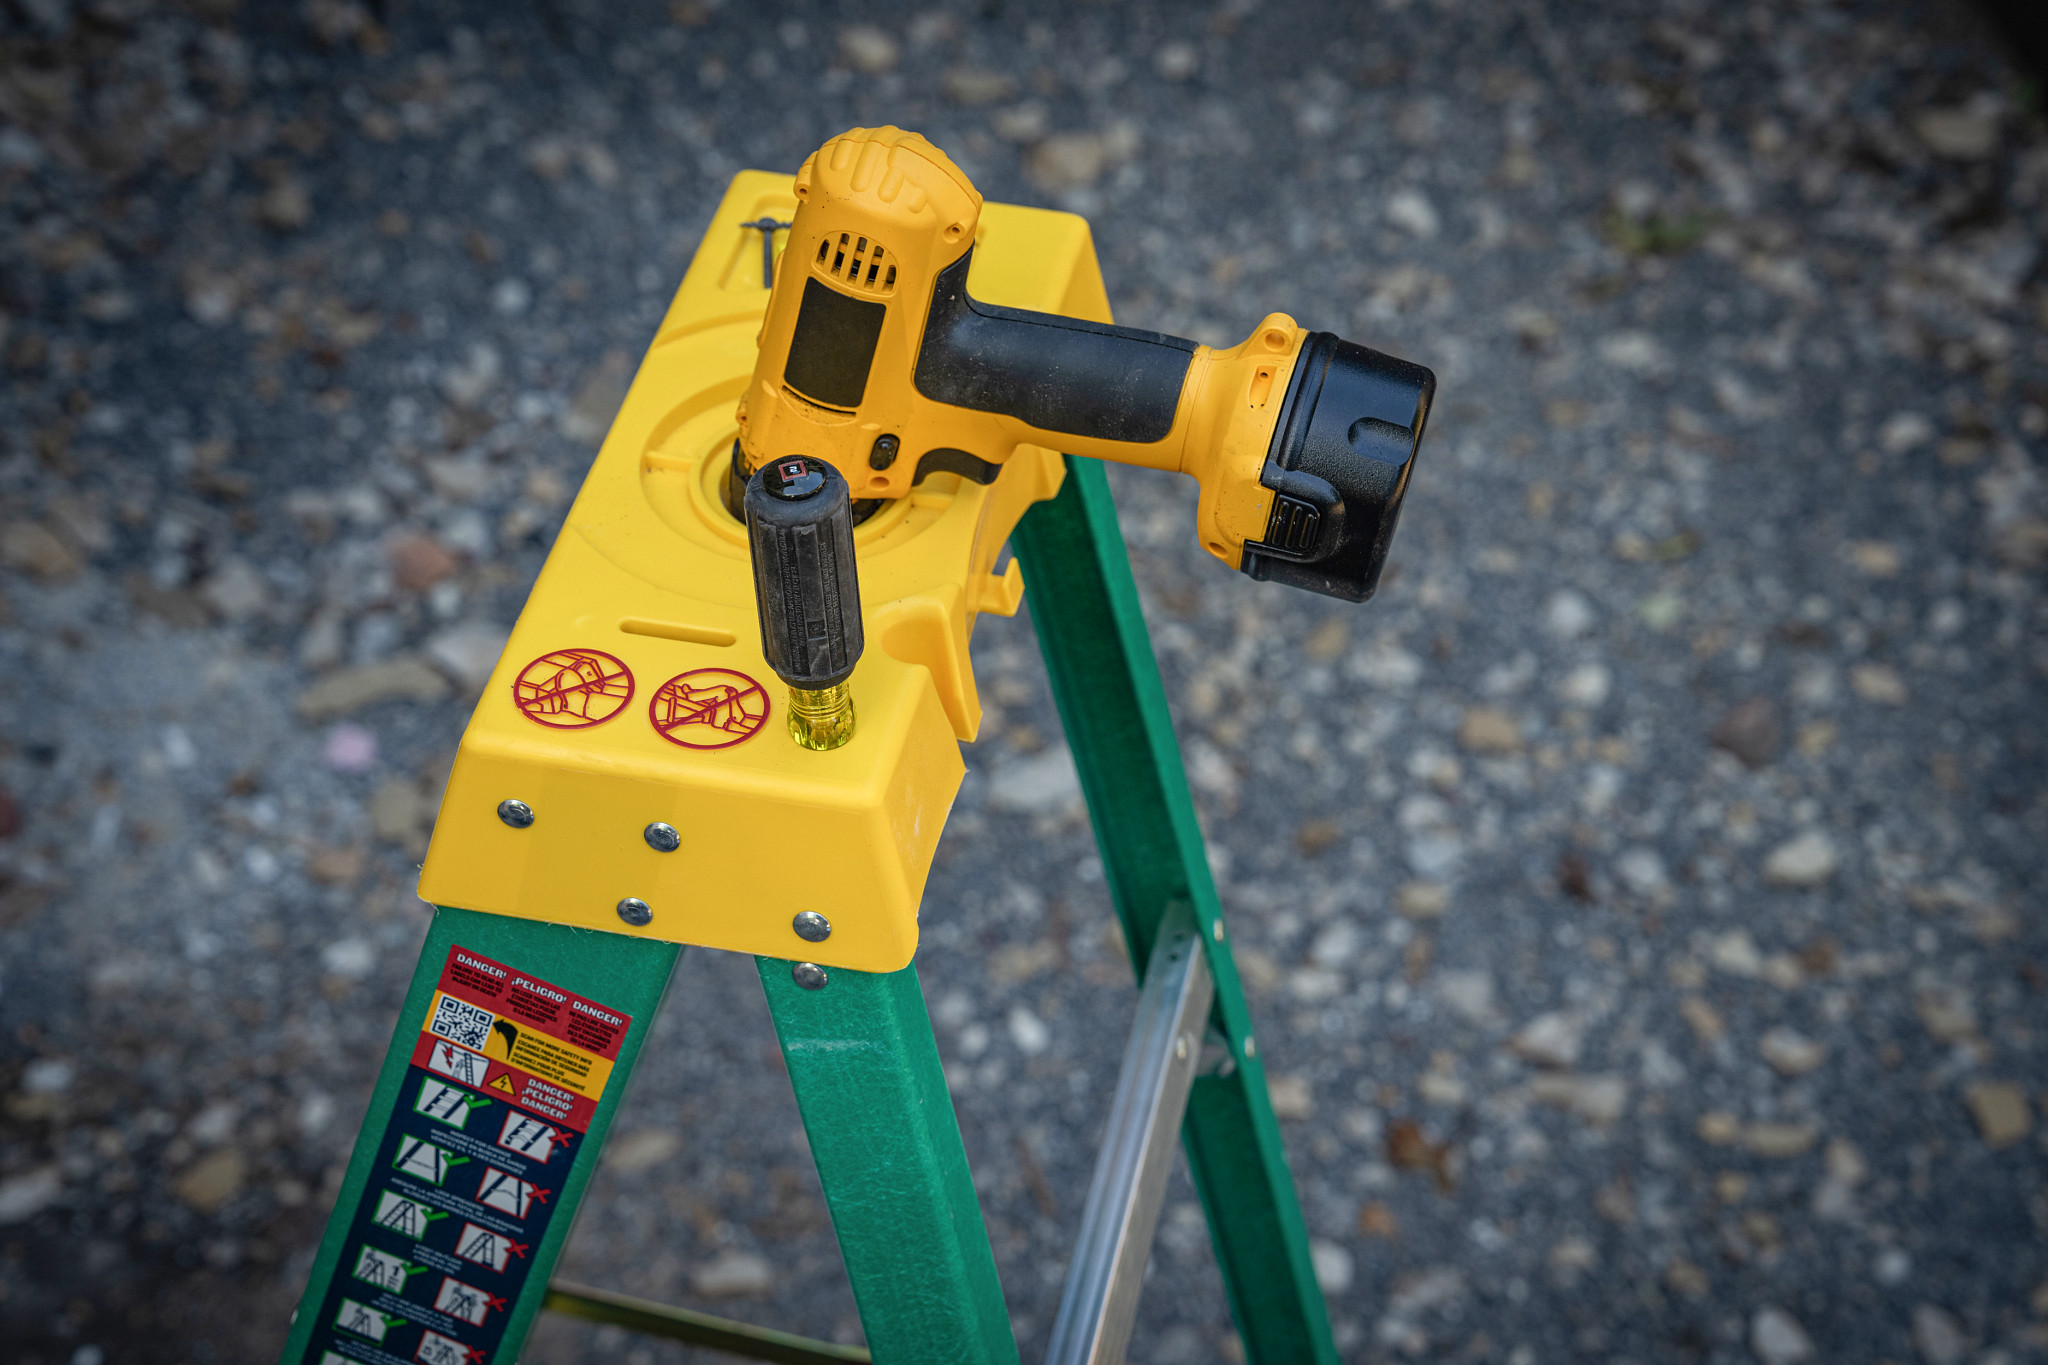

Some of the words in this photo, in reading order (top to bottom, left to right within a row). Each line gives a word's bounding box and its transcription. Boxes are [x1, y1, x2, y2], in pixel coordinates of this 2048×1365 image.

[451, 963, 473, 975] FAILURE
[480, 974, 494, 983] READ
[456, 953, 507, 979] DANGER!
[450, 969, 470, 980] LABELS
[469, 976, 481, 984] CAN
[481, 981, 494, 990] LEAD
[451, 976, 470, 987] INJURY
[479, 987, 496, 997] DEATH
[510, 975, 567, 1005] ¡PELIGRO!
[572, 1000, 622, 1026] DANGER!
[519, 1032, 534, 1041] SCAN
[534, 1038, 544, 1046] FOR
[545, 1042, 559, 1051] MORE
[560, 1048, 579, 1059] SAFETY
[579, 1056, 592, 1065] INFO
[540, 1048, 554, 1057] PARA
[536, 1061, 550, 1070] POUR
[551, 1067, 564, 1076] PLUS
[521, 1085, 573, 1113] ¡PELIGRO!
[527, 1077, 574, 1103] DANGER!
[520, 1096, 567, 1120] DANGER!
